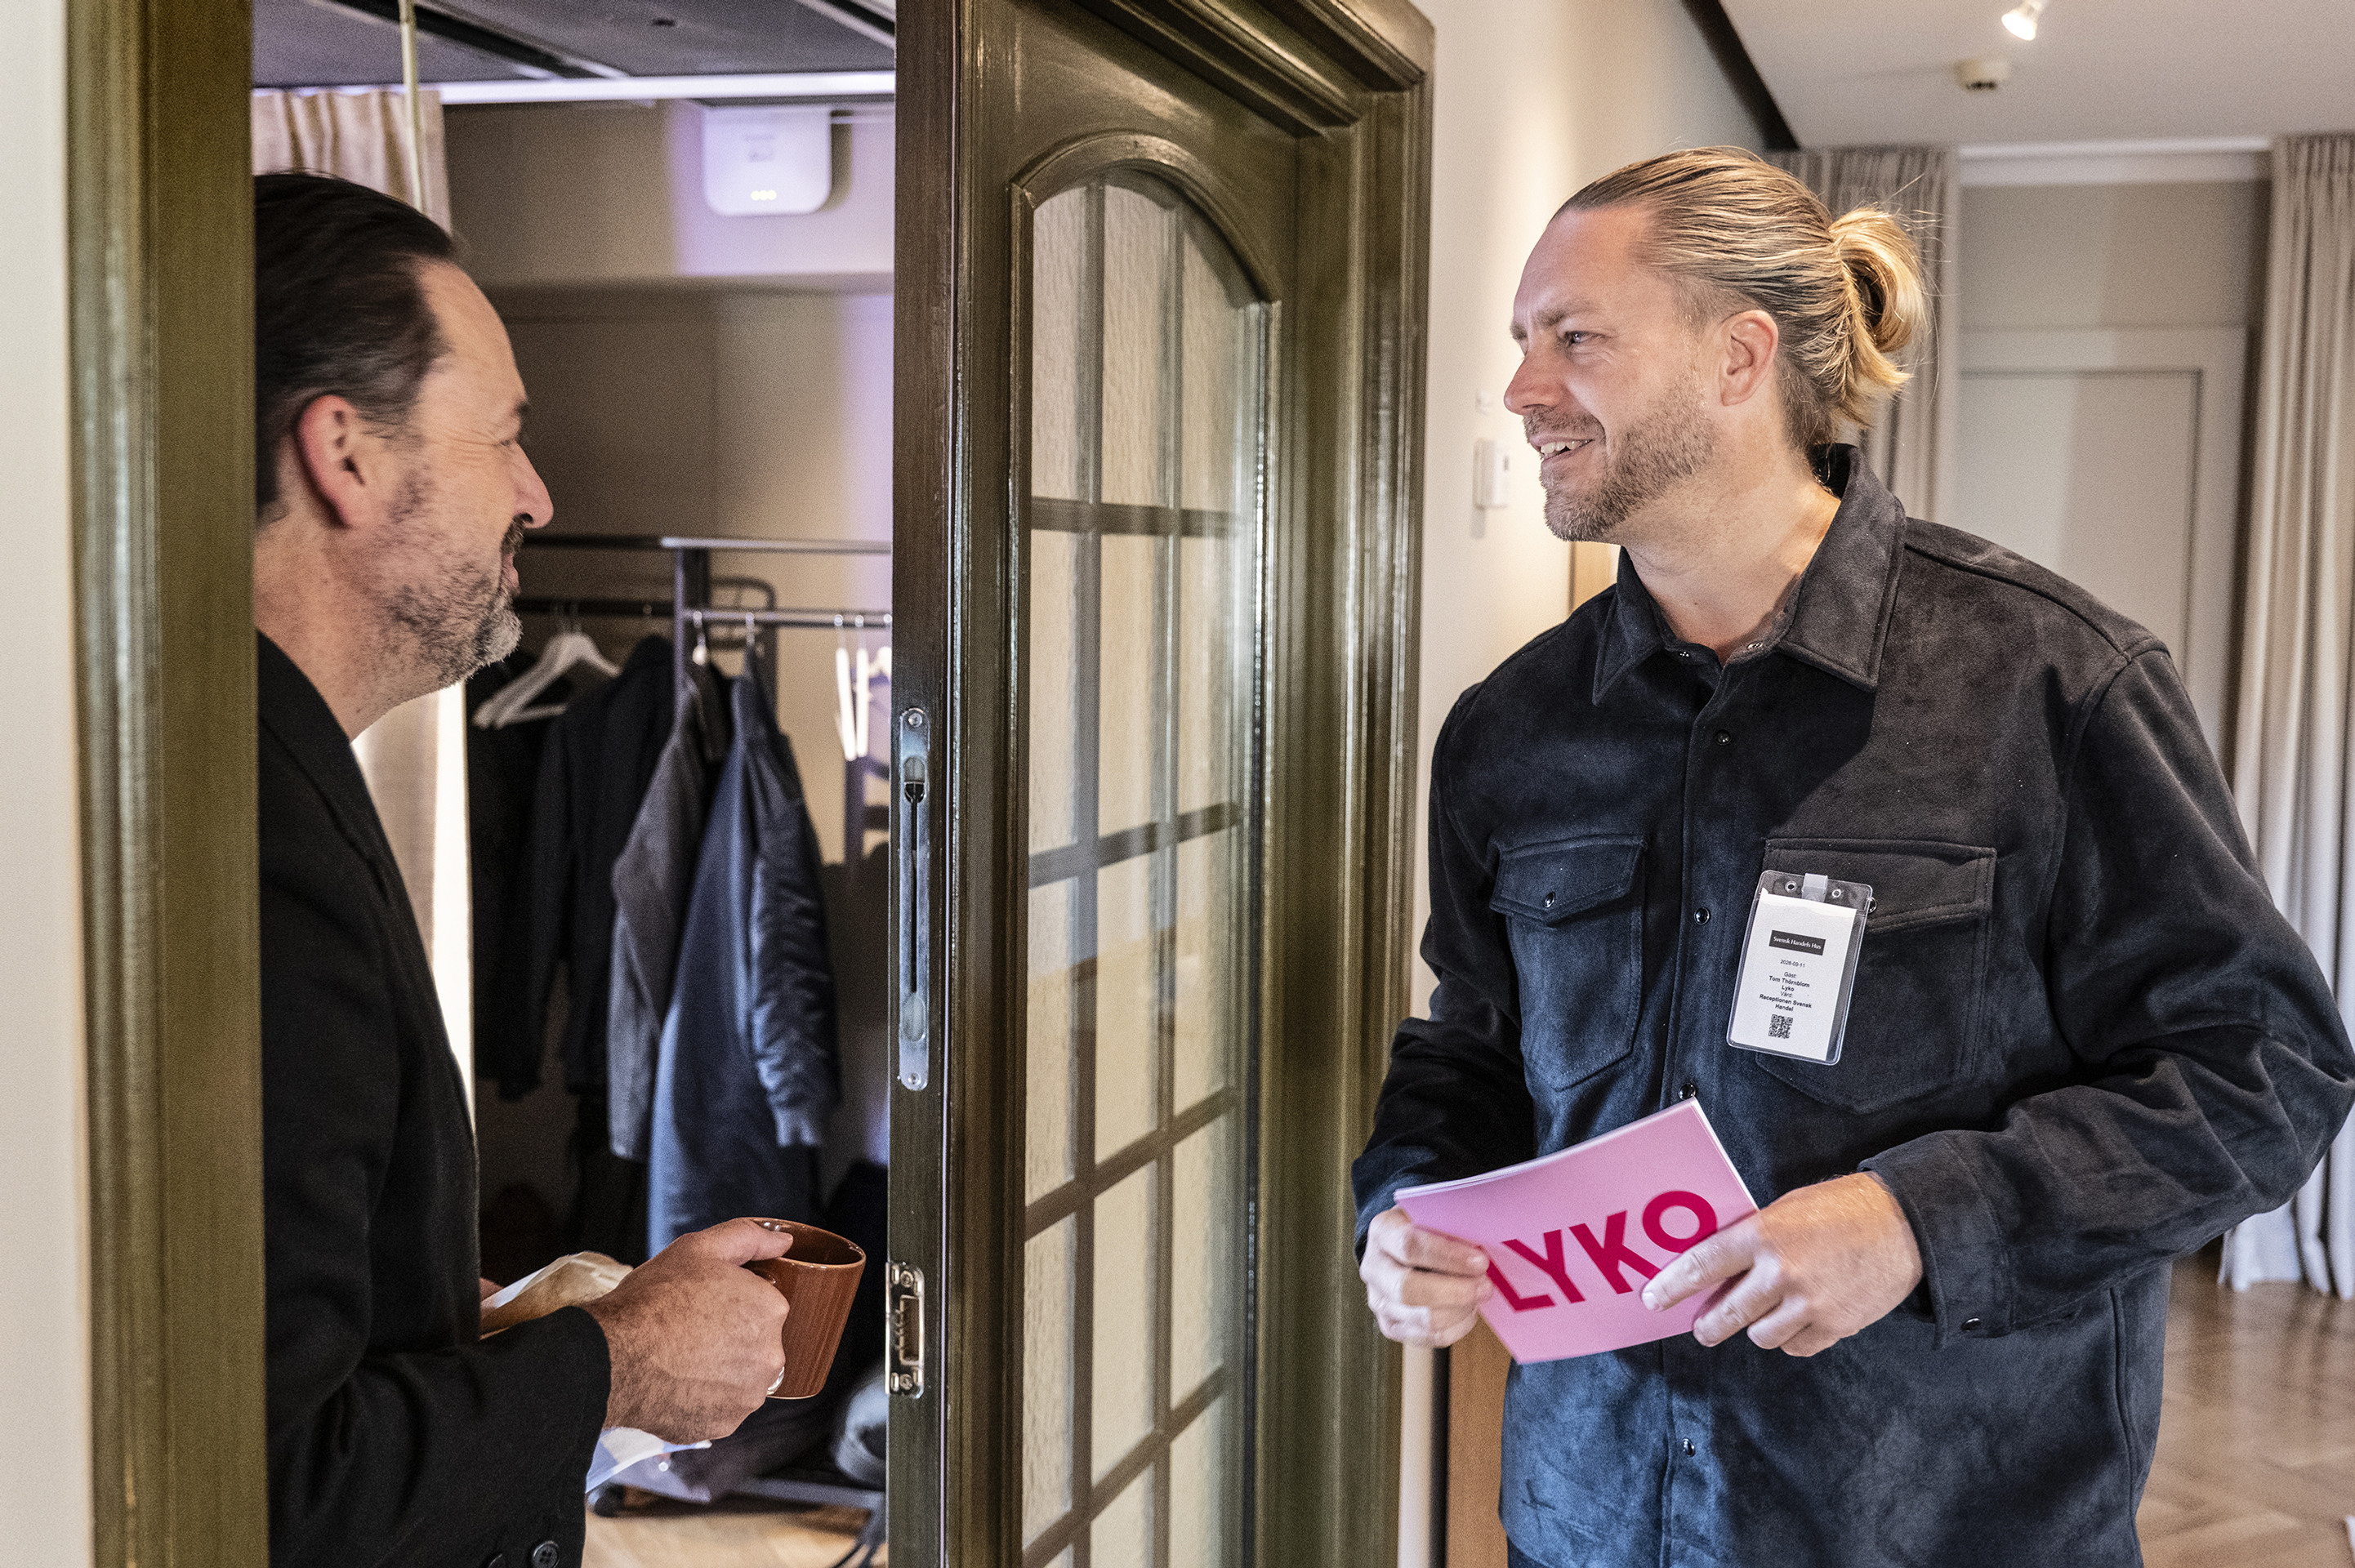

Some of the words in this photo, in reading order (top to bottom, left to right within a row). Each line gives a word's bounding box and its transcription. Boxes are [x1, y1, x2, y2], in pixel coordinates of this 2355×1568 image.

[1773, 936, 1790, 944] Svensk
[1791, 939, 1810, 947] Handels
[1760, 994, 1792, 1004] Receptionen
[1793, 1000, 1812, 1009] Svensk
[1775, 1004, 1794, 1012] Handel
[1487, 1191, 1718, 1312] LYKO
